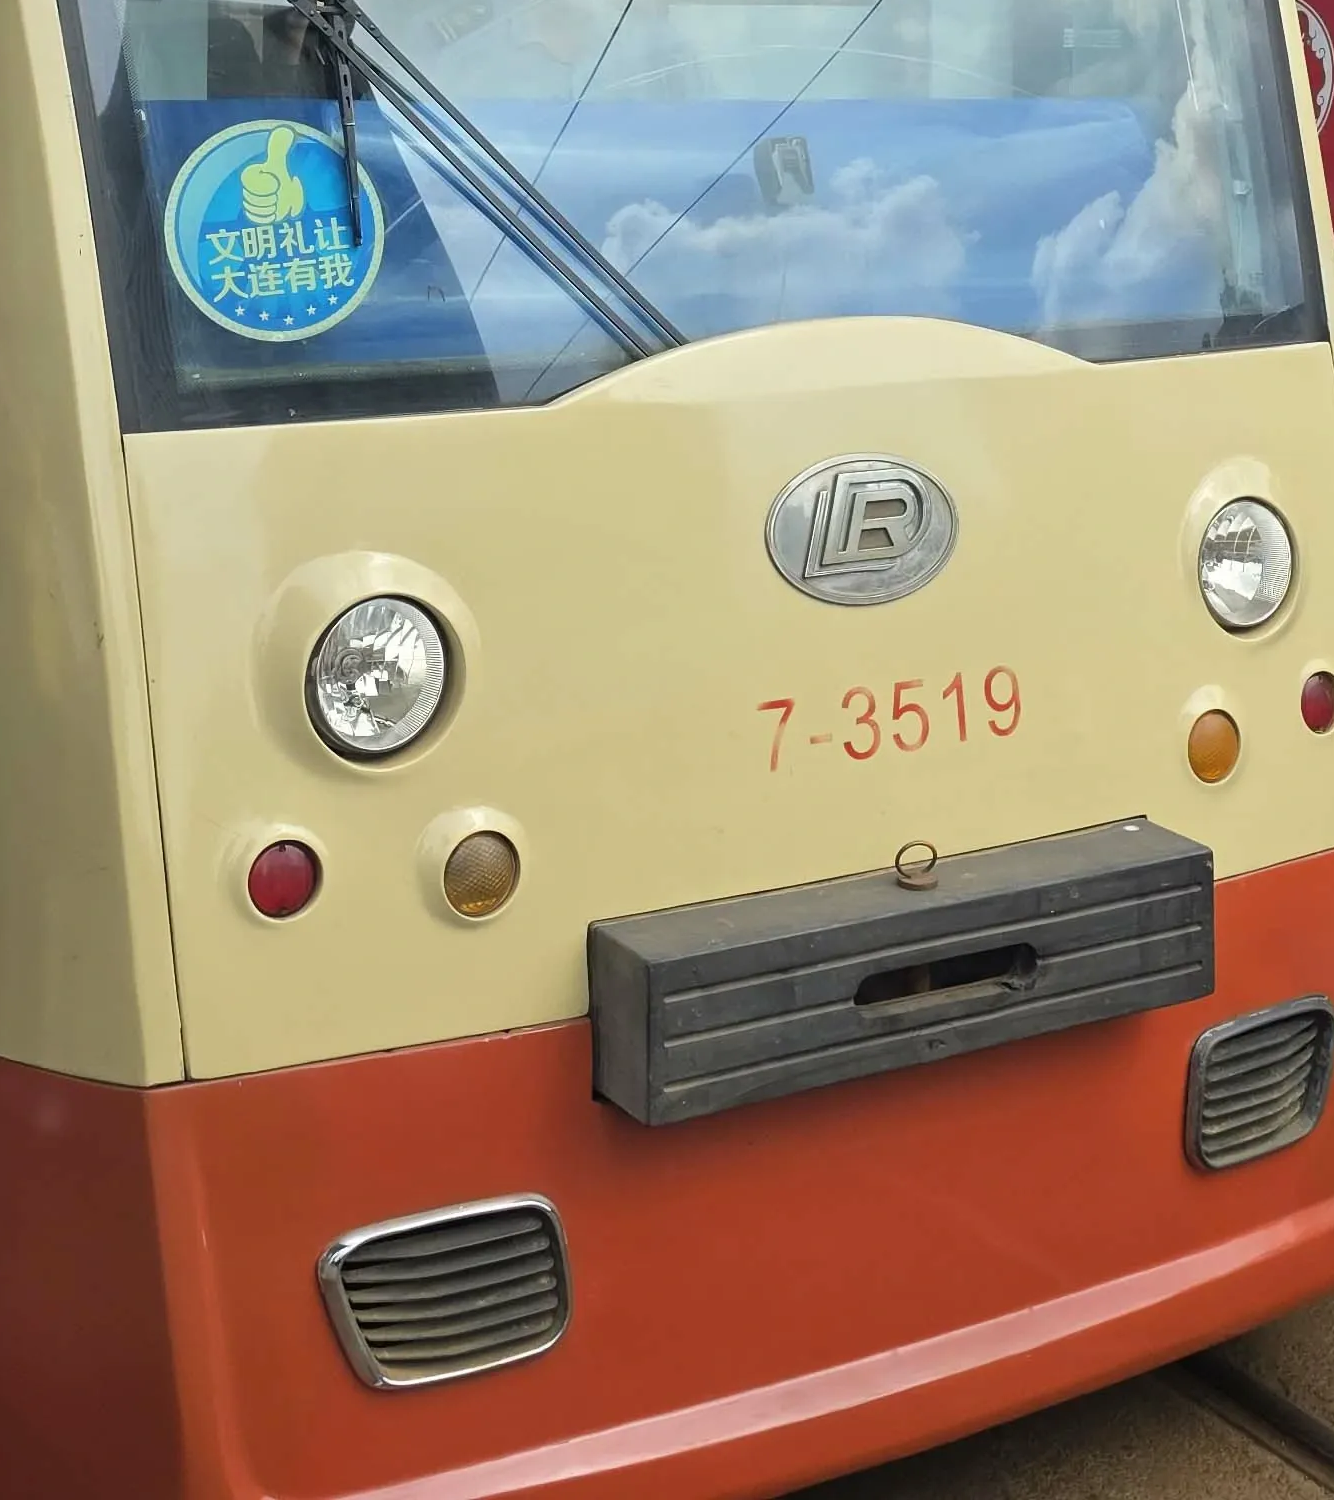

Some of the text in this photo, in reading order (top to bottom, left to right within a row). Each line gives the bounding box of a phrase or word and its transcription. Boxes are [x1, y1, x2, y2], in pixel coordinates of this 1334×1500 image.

[206, 217, 351, 265] 文明礼让
[211, 252, 355, 303] 大连有我
[756, 665, 1022, 772] 7-3519
